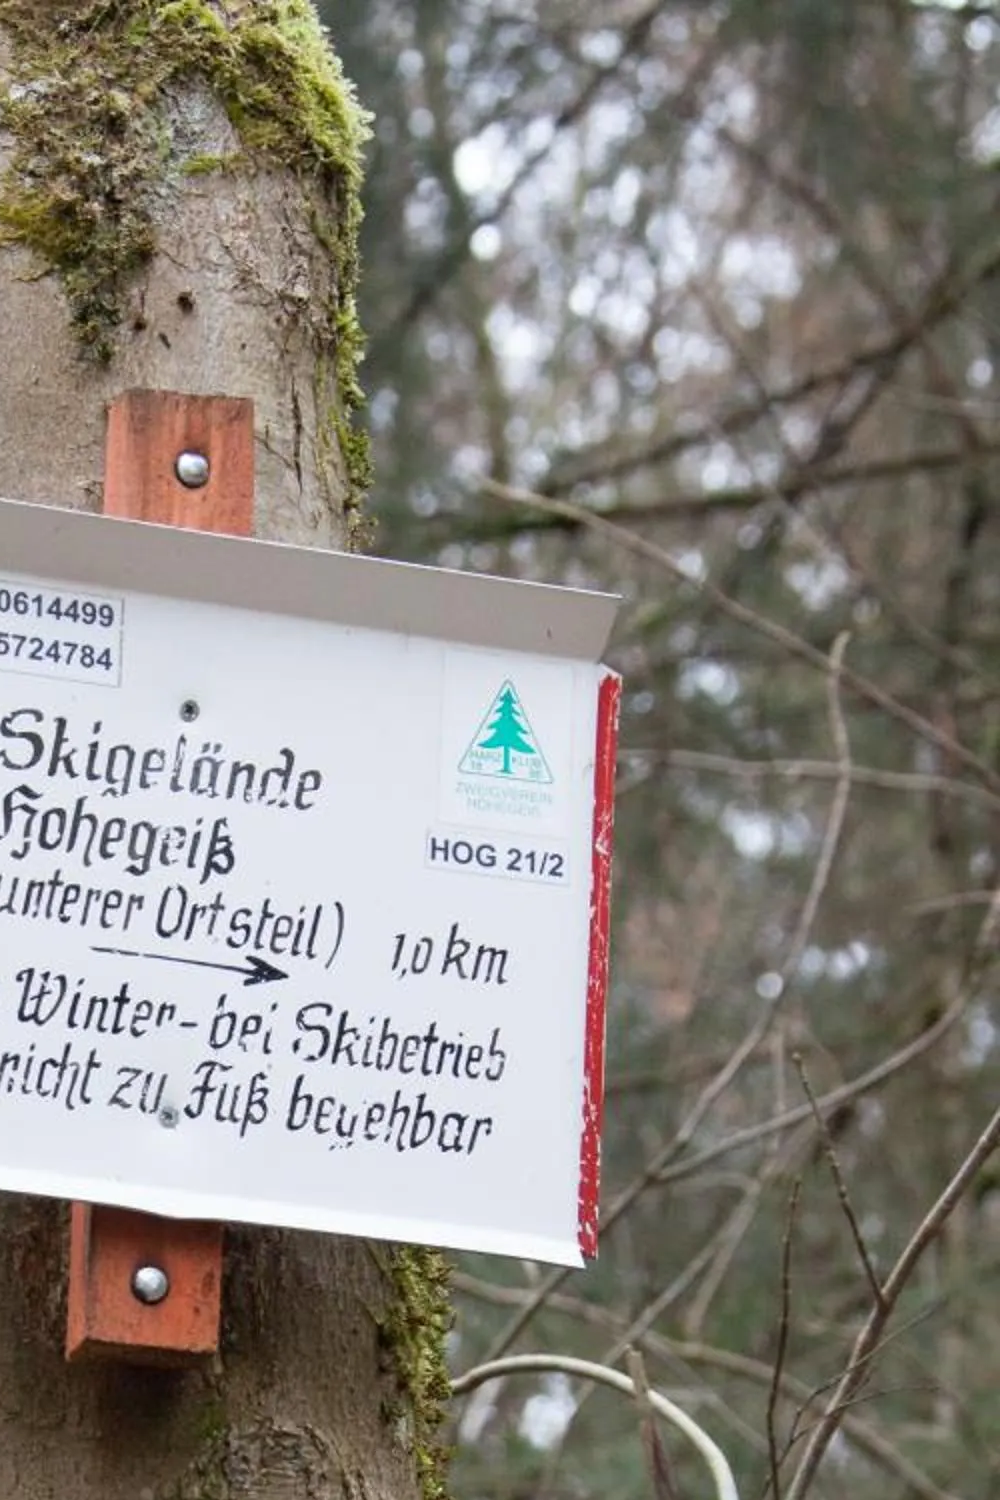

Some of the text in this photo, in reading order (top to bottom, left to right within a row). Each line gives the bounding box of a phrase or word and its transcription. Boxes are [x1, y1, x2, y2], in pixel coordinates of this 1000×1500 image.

[431, 837, 564, 877] HOG 21/2
[156, 884, 344, 969] Ortsteil)
[391, 933, 433, 981] 1,0
[441, 922, 508, 985] km
[209, 993, 278, 1055] bei
[292, 1002, 506, 1082] Skibetrieb
[107, 1066, 169, 1115] zu
[184, 1060, 271, 1139] Fuß
